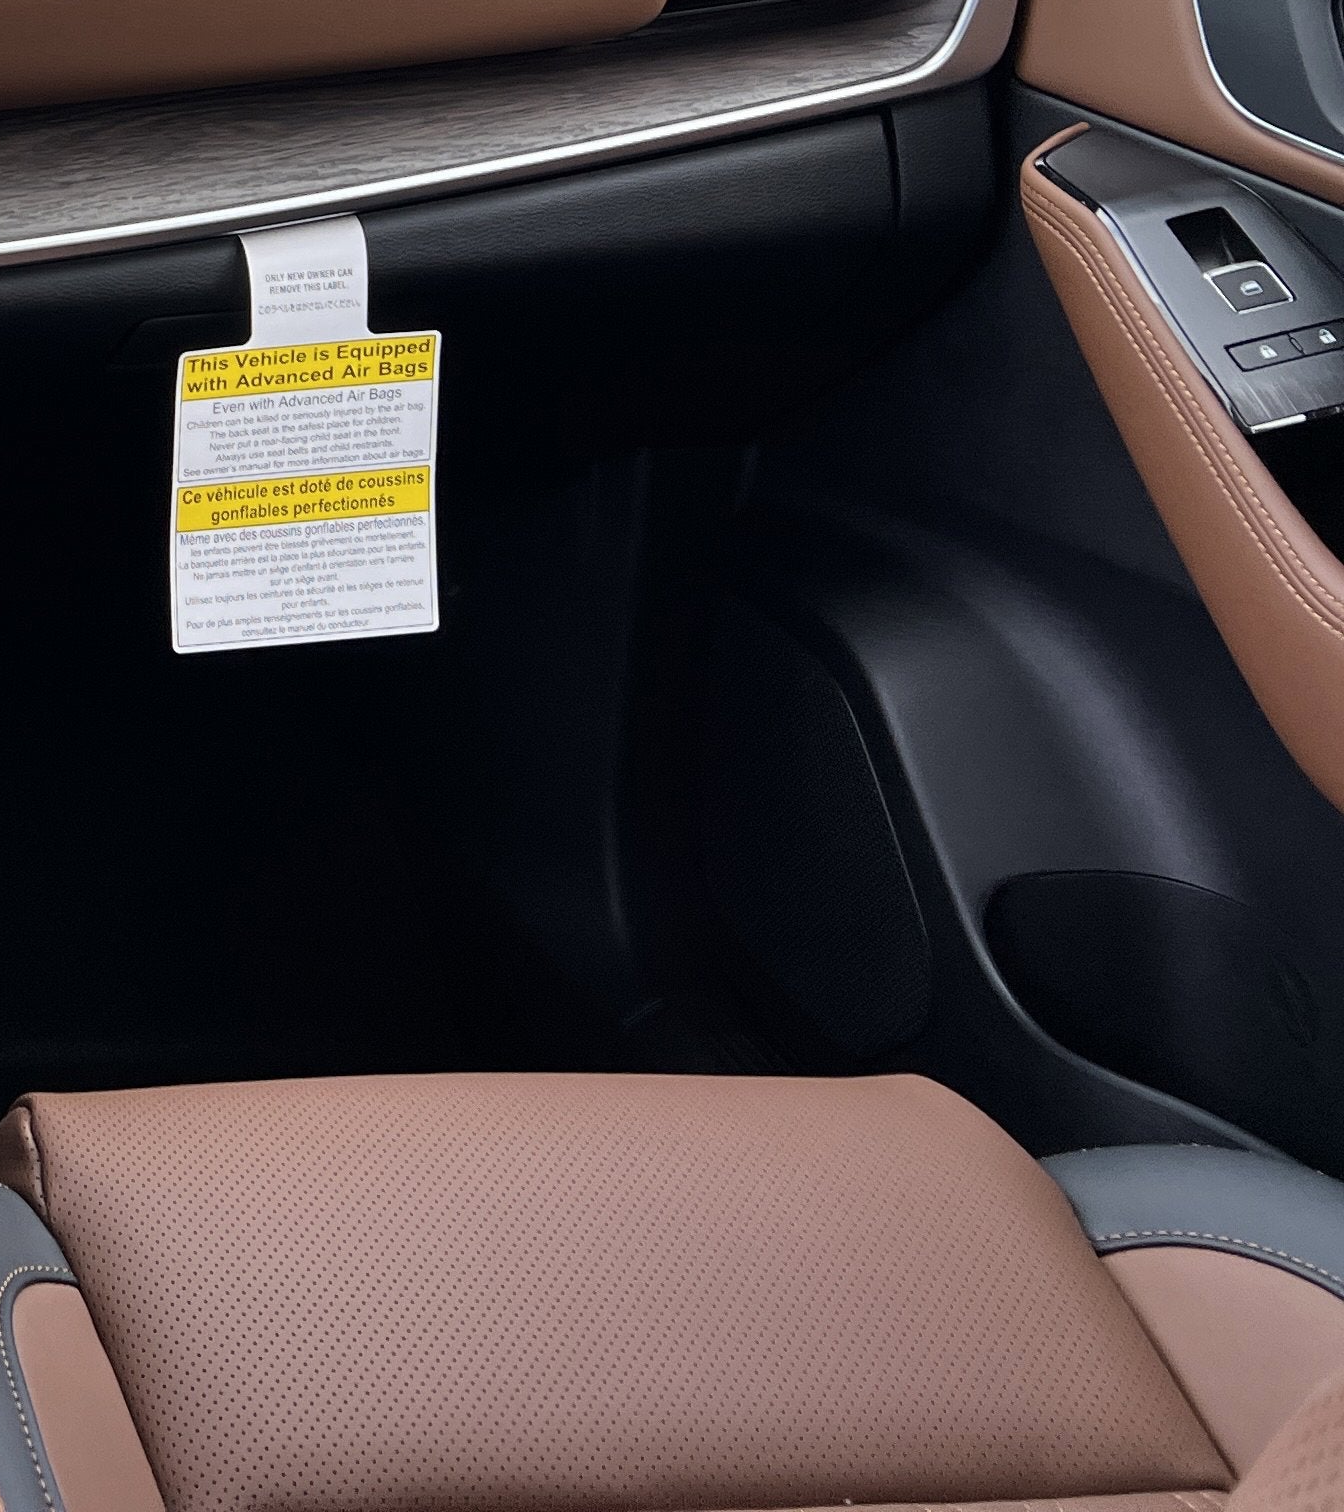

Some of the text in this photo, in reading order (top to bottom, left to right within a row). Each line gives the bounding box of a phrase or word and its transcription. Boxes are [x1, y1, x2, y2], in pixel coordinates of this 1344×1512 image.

[188, 340, 429, 373] This Vehicle is Equipped
[187, 362, 427, 393] with Advanced Air Bags
[212, 388, 401, 413] Even with Advanced Air Bags
[182, 472, 424, 504] Ce véhicule est doté de coussins
[211, 494, 394, 526] gonflables perfectionnés
